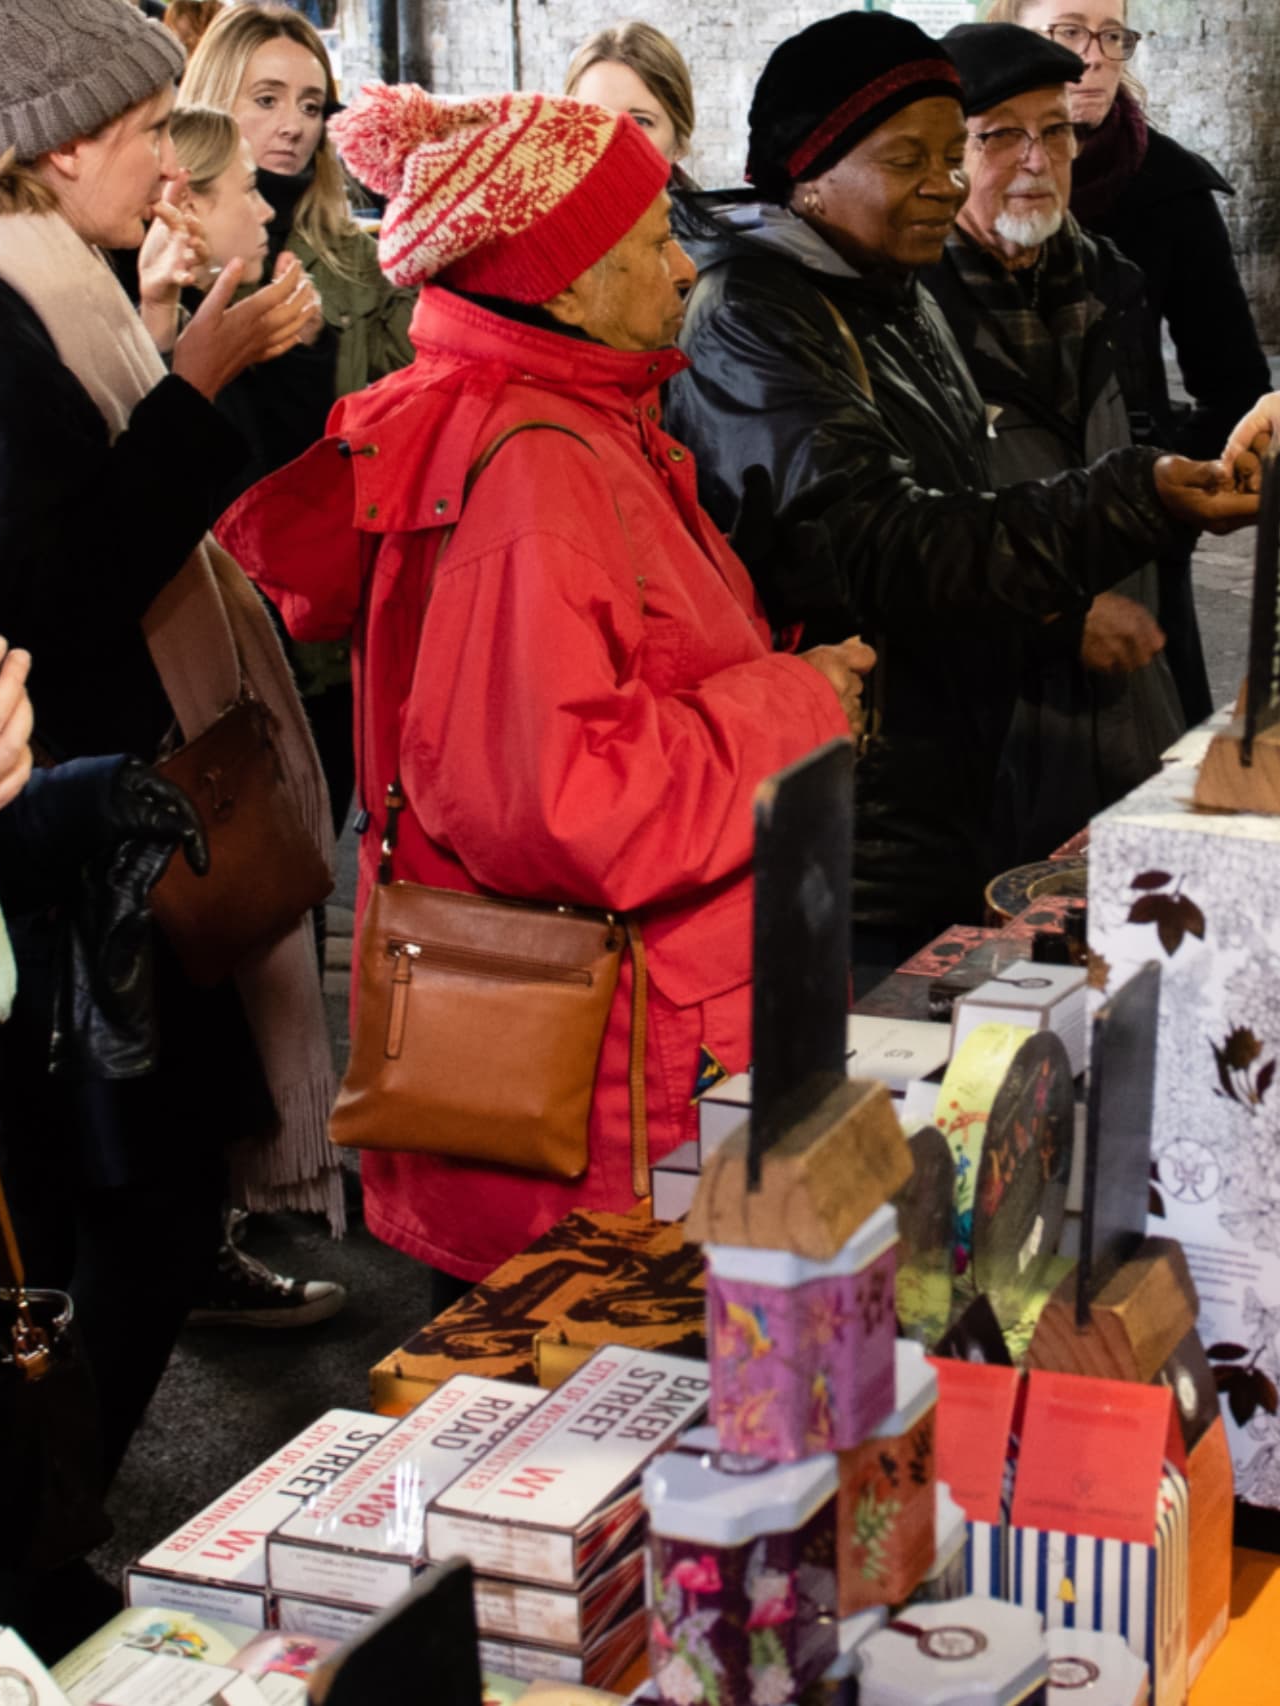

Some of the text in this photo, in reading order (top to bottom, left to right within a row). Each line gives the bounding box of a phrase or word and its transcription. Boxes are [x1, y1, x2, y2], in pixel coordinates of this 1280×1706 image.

[431, 1395, 515, 1450] ROAD
[460, 1360, 619, 1490] CITY OF WESTMINSTER
[567, 1366, 668, 1442] STREET
[616, 1374, 710, 1442] BAKER
[163, 1423, 338, 1553] CITY OF WESTMINSTER
[277, 1430, 385, 1505] STREET
[304, 1389, 467, 1519] CITY OF WESTMINSTER
[498, 1466, 565, 1499] W1
[199, 1529, 270, 1561] W1
